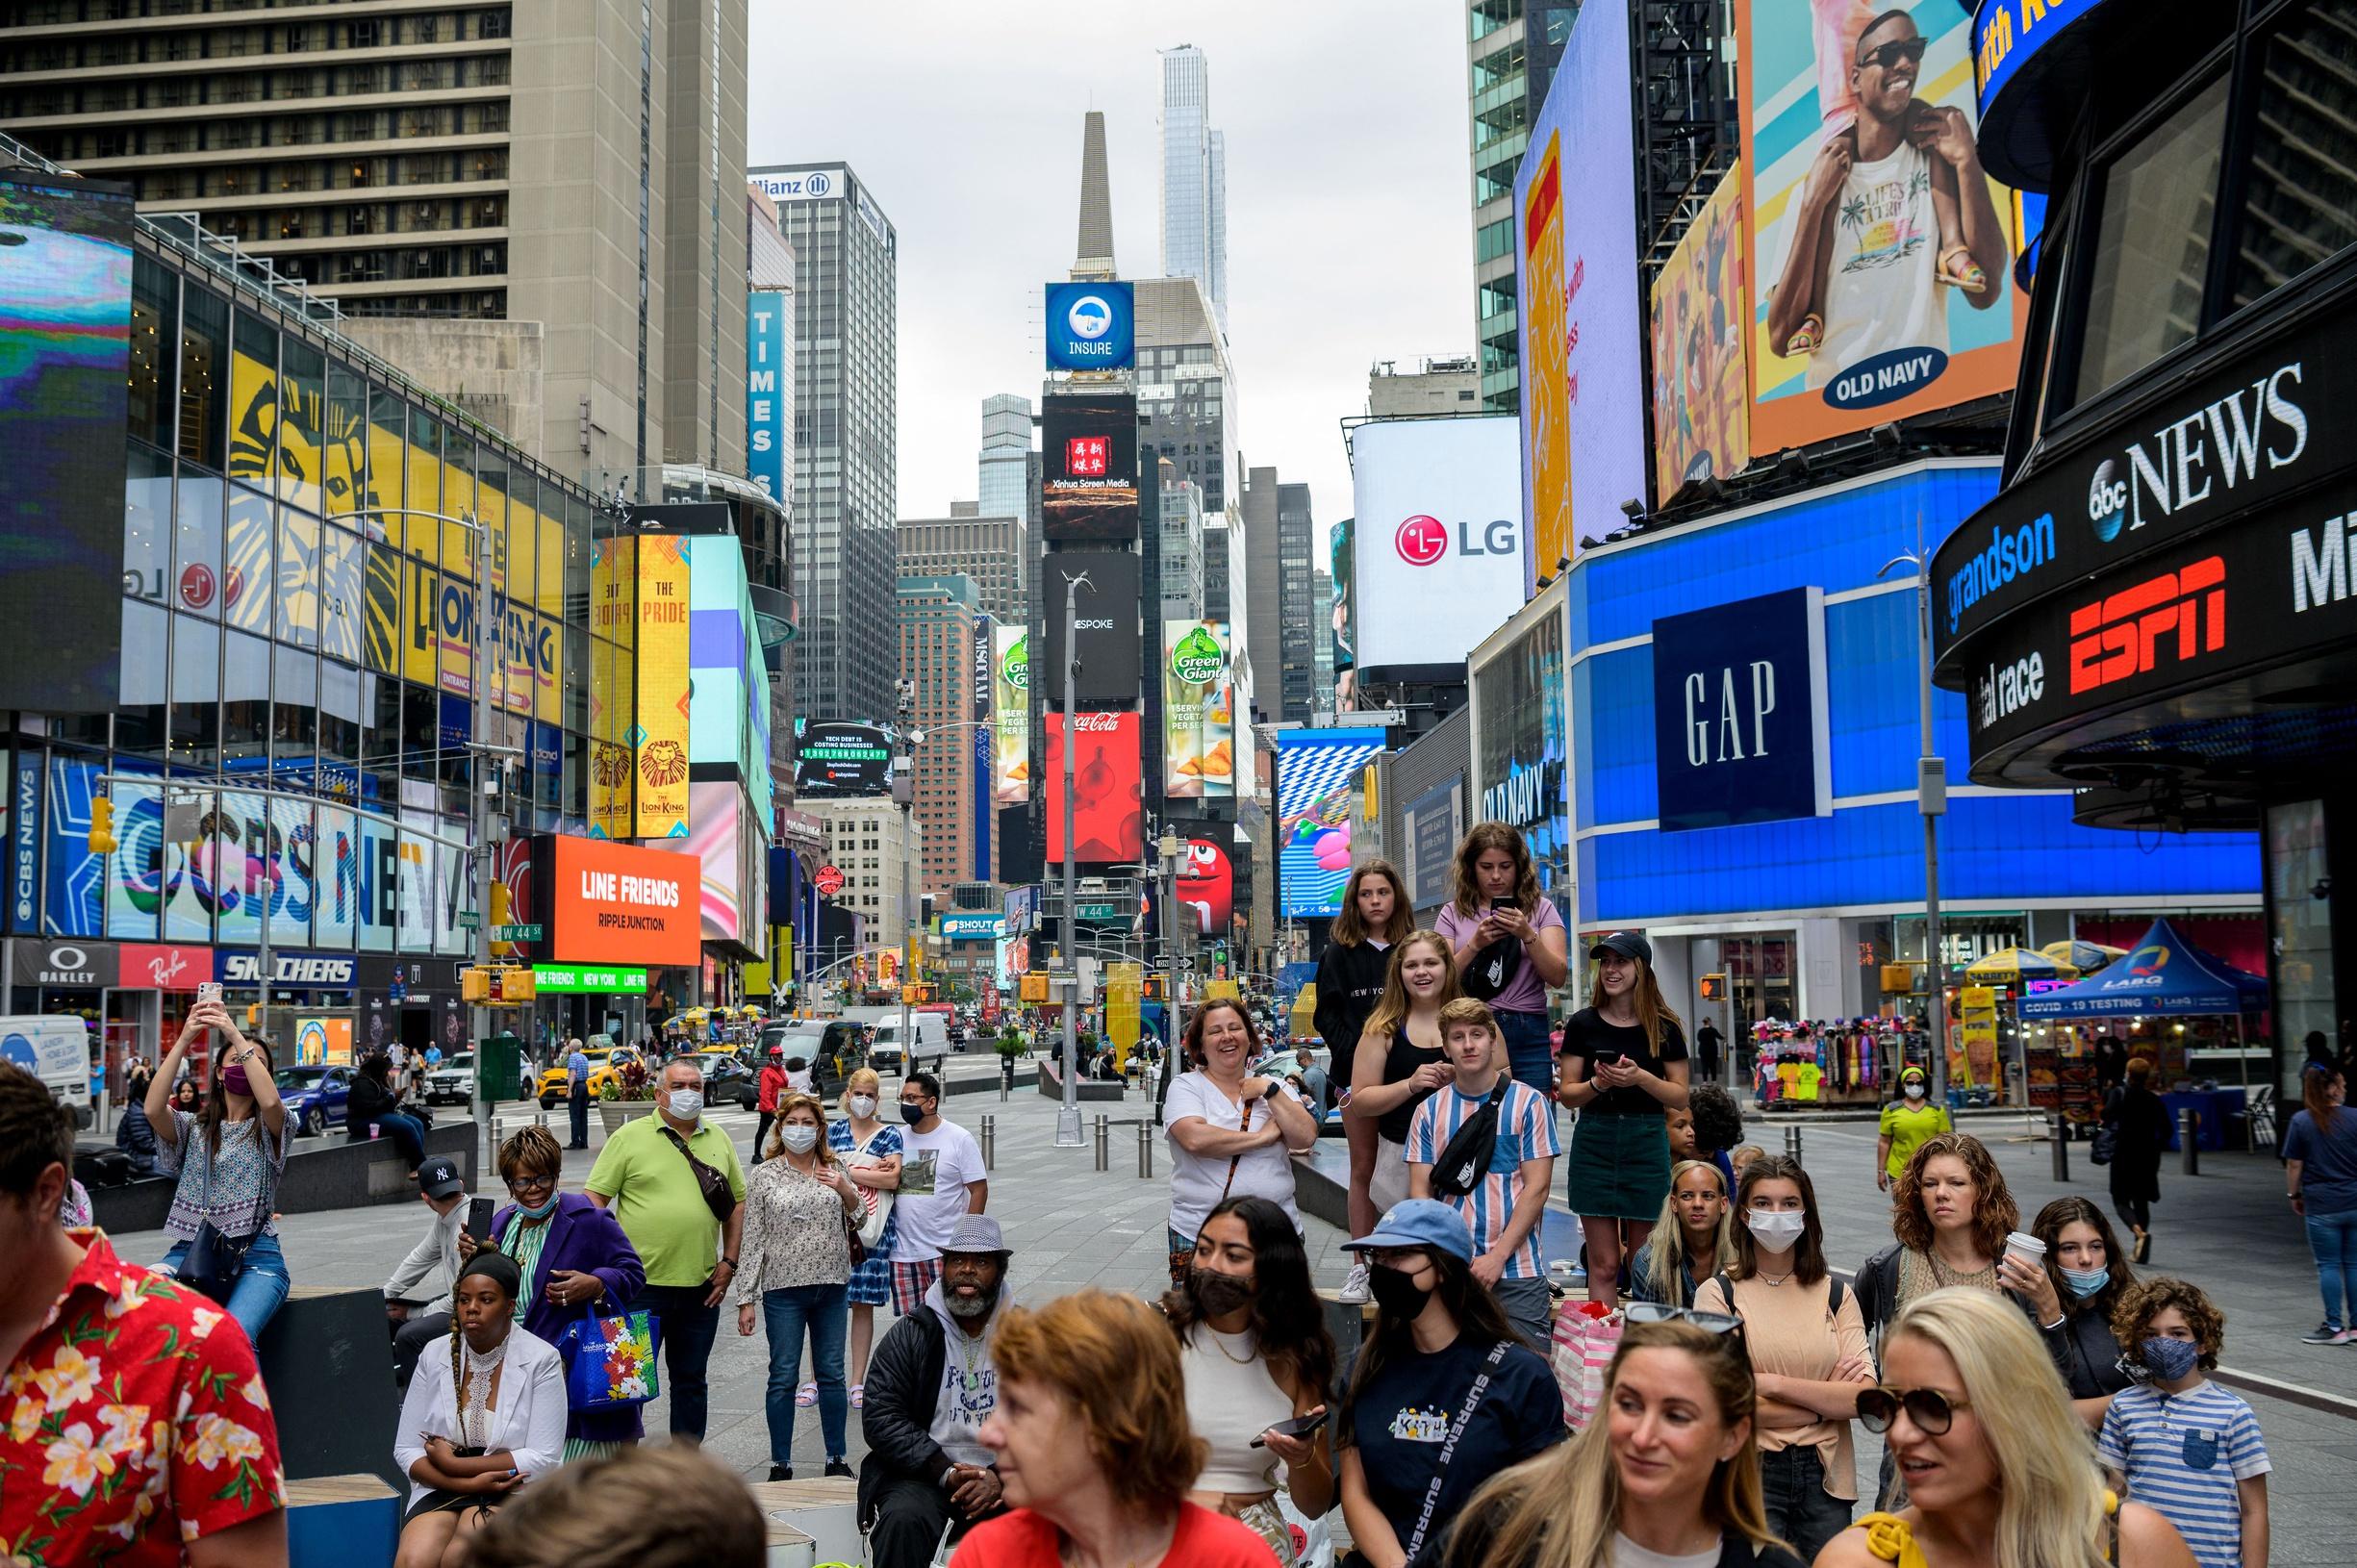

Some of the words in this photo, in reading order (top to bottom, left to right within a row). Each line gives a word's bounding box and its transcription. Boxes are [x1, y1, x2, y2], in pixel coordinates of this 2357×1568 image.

[1977, 5, 2013, 99] with
[1069, 341, 1112, 355] INSURE
[1566, 320, 1579, 358] ess
[750, 312, 775, 452] TIMES
[1836, 369, 1875, 402] OLD
[1878, 354, 1934, 392] NAVY
[2088, 477, 2128, 521] abc
[2125, 362, 2308, 531] NEWS
[1052, 479, 1078, 489] Xinhua
[1079, 479, 1105, 489] Screen
[1106, 479, 1129, 489] Media
[1458, 519, 1515, 556] LG
[1948, 512, 2056, 635] grandson
[656, 582, 673, 596] THE
[643, 601, 686, 624] PRIDE
[1075, 620, 1113, 629] ESPOKE
[2069, 555, 2226, 695] ESPN
[1178, 656, 1221, 668] Green
[1182, 667, 1223, 680] Giant
[443, 673, 470, 690] ENTRANCE
[1997, 650, 2044, 718] race
[1685, 660, 1776, 767] GAP
[1508, 761, 1544, 826] NAVY
[20, 770, 36, 846] NEWS
[642, 801, 661, 815] LION
[662, 801, 685, 815] KING
[18, 849, 35, 899] CBS
[581, 870, 617, 902] LINE
[621, 874, 679, 908] FRIENDS
[598, 913, 625, 928] RIPPLE
[627, 915, 665, 931] JUNCTION
[1078, 907, 1086, 917] W
[1089, 906, 1102, 917] 44
[503, 926, 513, 939] W
[517, 926, 530, 939] 44
[958, 920, 992, 929] SHOUT
[39, 971, 95, 983] OAKLEY
[223, 955, 354, 983] SKCHERS
[535, 971, 546, 985] INE
[547, 972, 575, 986] FRIENDS
[584, 973, 598, 986] NEW
[599, 973, 617, 986] YORK
[623, 974, 637, 986] LINE
[1351, 988, 1367, 998] NEW
[2102, 974, 2164, 989] LABQ
[2025, 1001, 2062, 1013] COVID
[2071, 1000, 2086, 1011] 19
[2089, 998, 2142, 1009] TESTING
[1439, 1373, 1489, 1465] SUPREME
[1406, 1477, 1442, 1562] SUPREM
